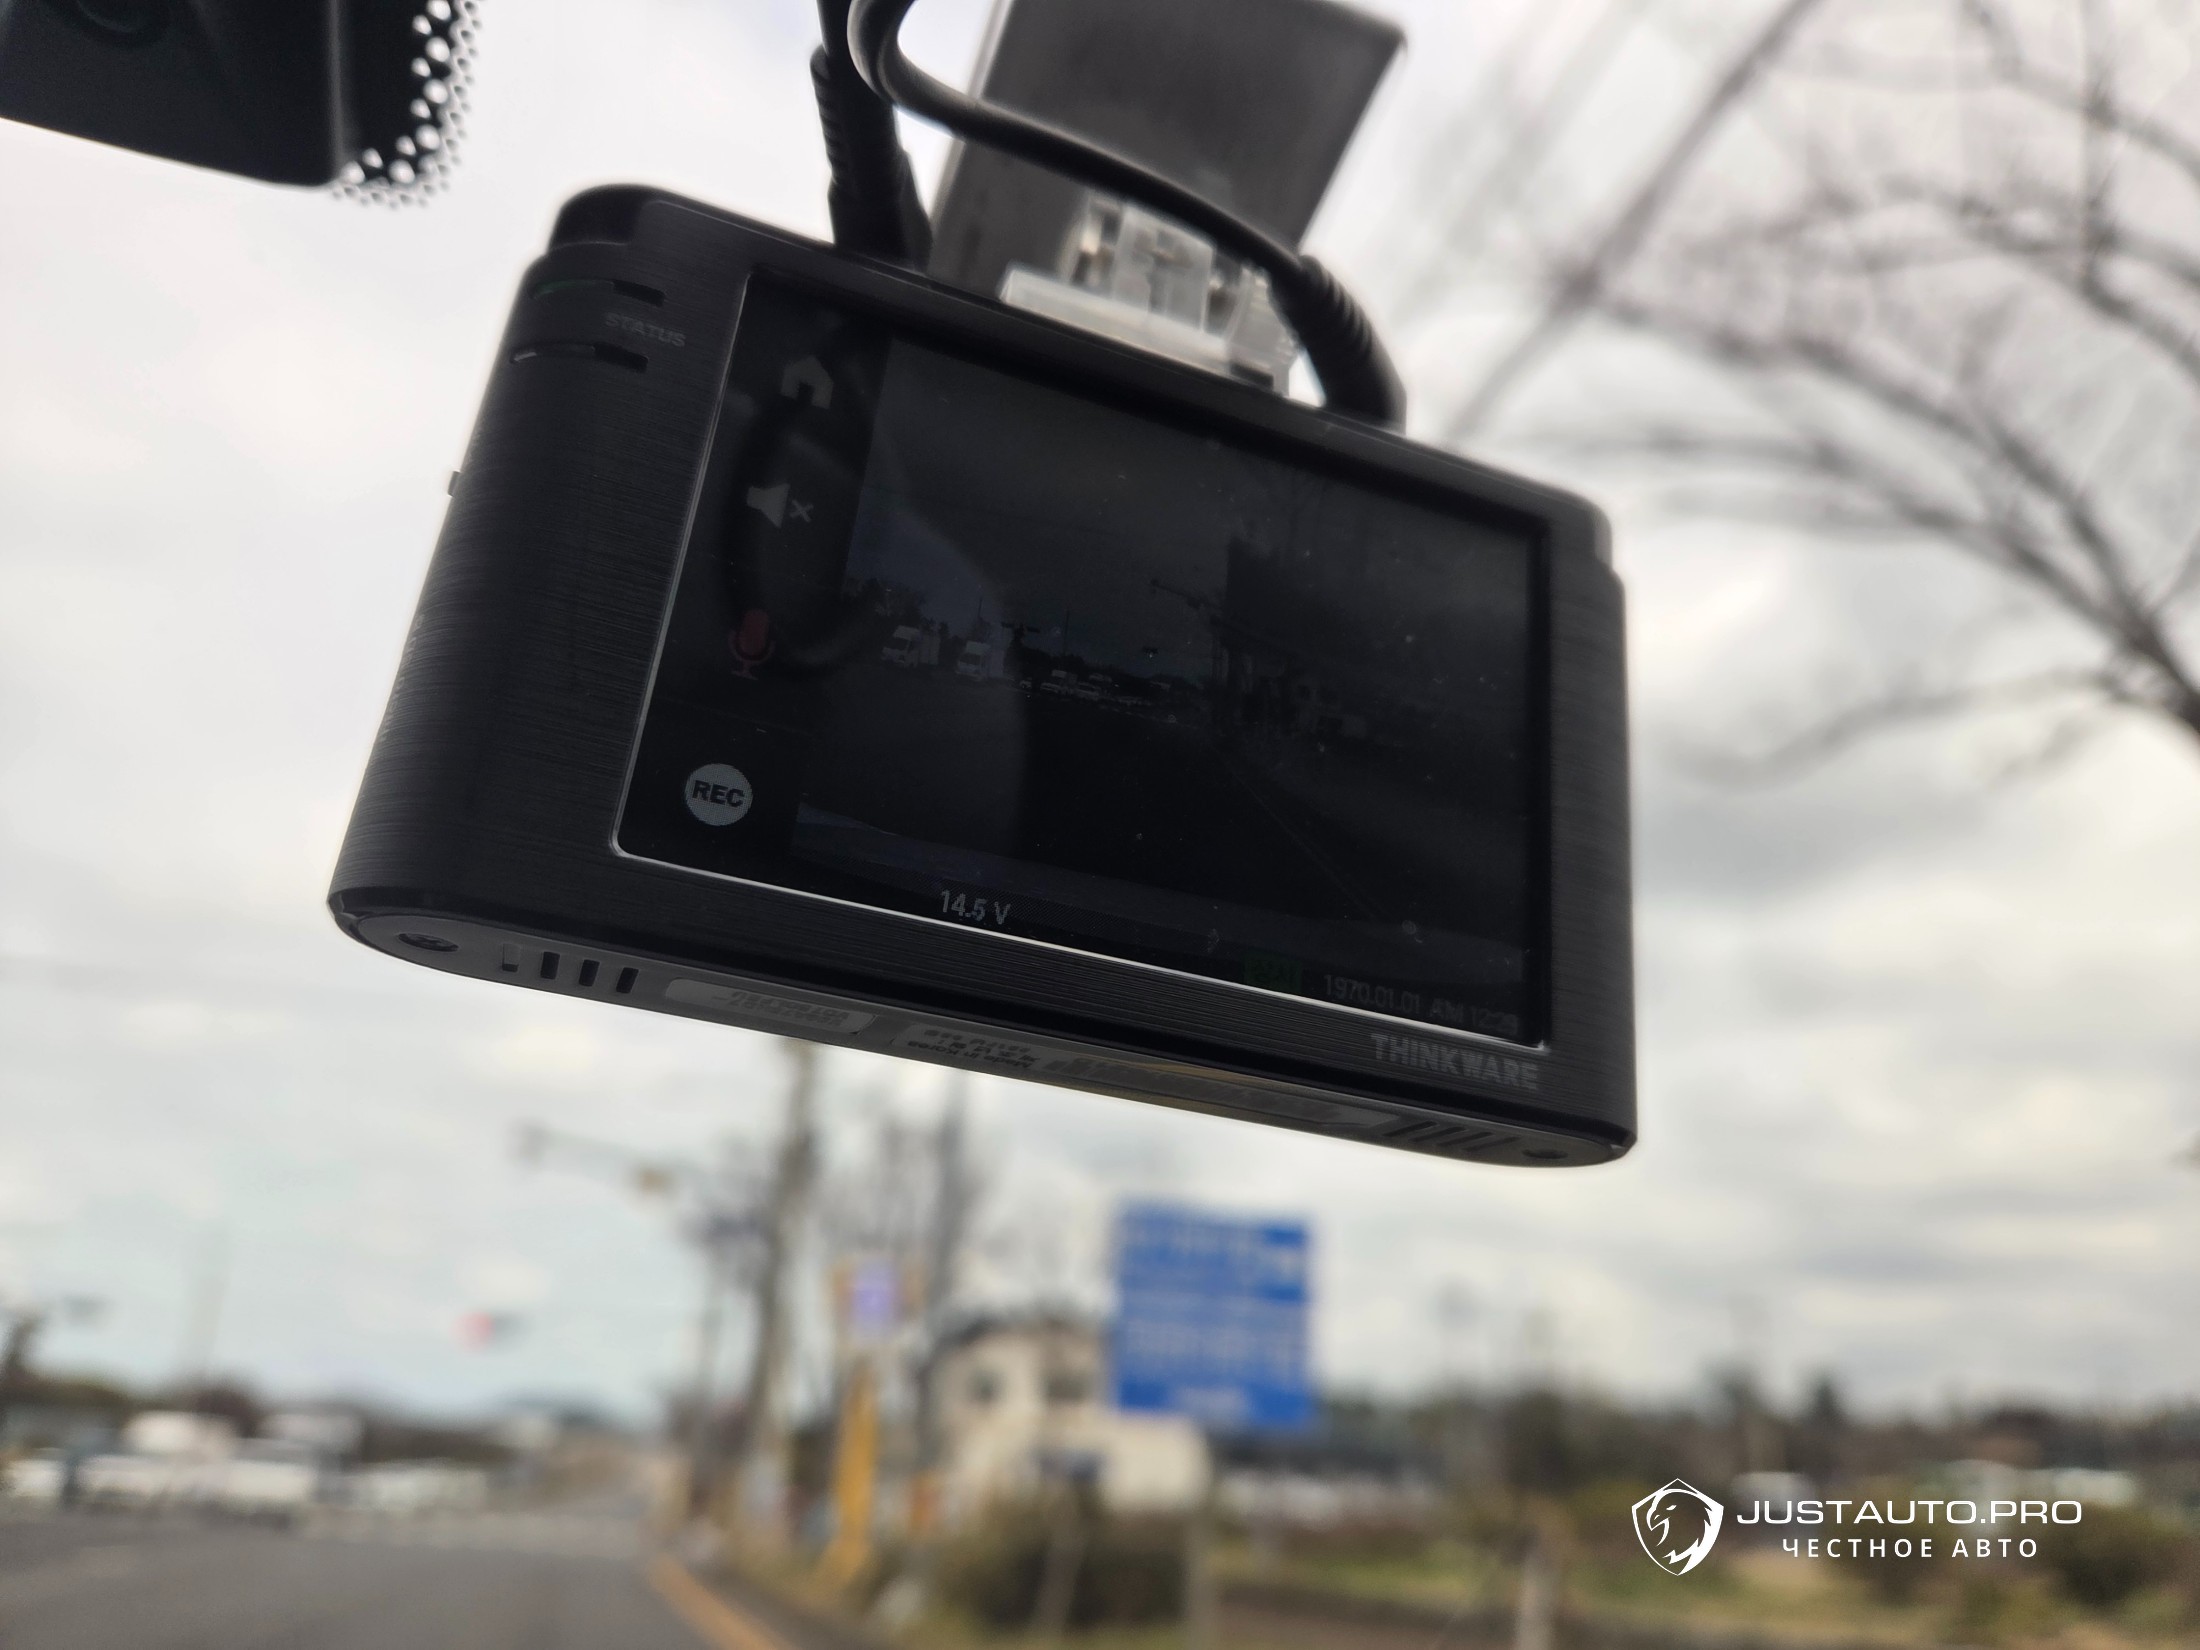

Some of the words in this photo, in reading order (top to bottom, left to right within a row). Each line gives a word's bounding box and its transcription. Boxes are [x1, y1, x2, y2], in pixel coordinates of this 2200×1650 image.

[605, 312, 686, 346] STATUS
[691, 780, 745, 809] REC
[940, 890, 987, 921] 14.5
[993, 902, 1011, 925] V
[1324, 974, 1420, 1014] 1970.01.01
[1428, 997, 1465, 1024] AM
[1371, 1034, 1537, 1089] THINKWARE
